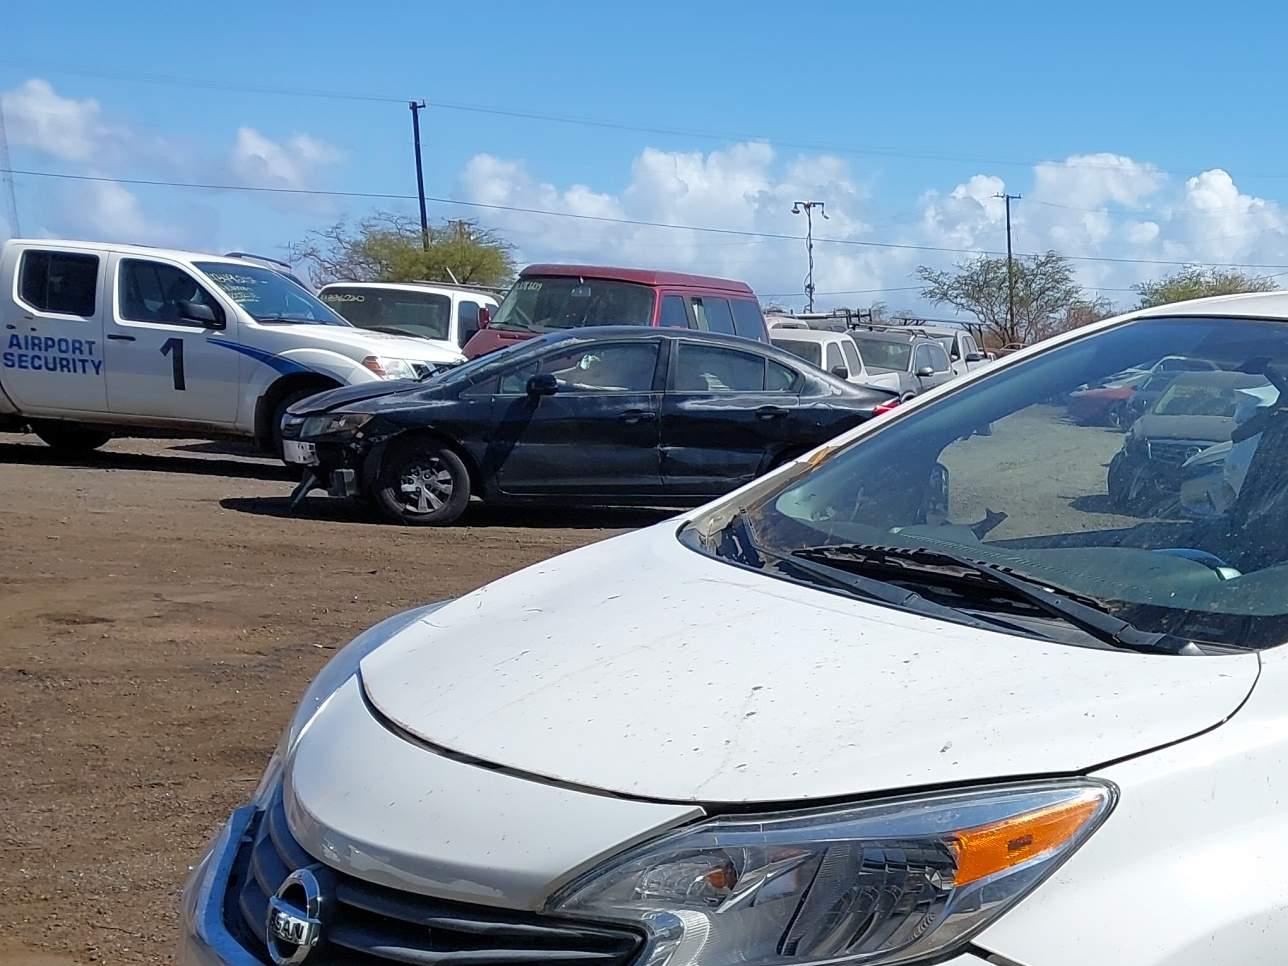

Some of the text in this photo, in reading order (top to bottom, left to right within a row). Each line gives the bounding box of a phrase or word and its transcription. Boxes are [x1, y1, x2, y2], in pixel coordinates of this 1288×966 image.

[8, 334, 96, 355] AIRPORT
[3, 352, 102, 375] SECURITY
[159, 337, 186, 391] 1
